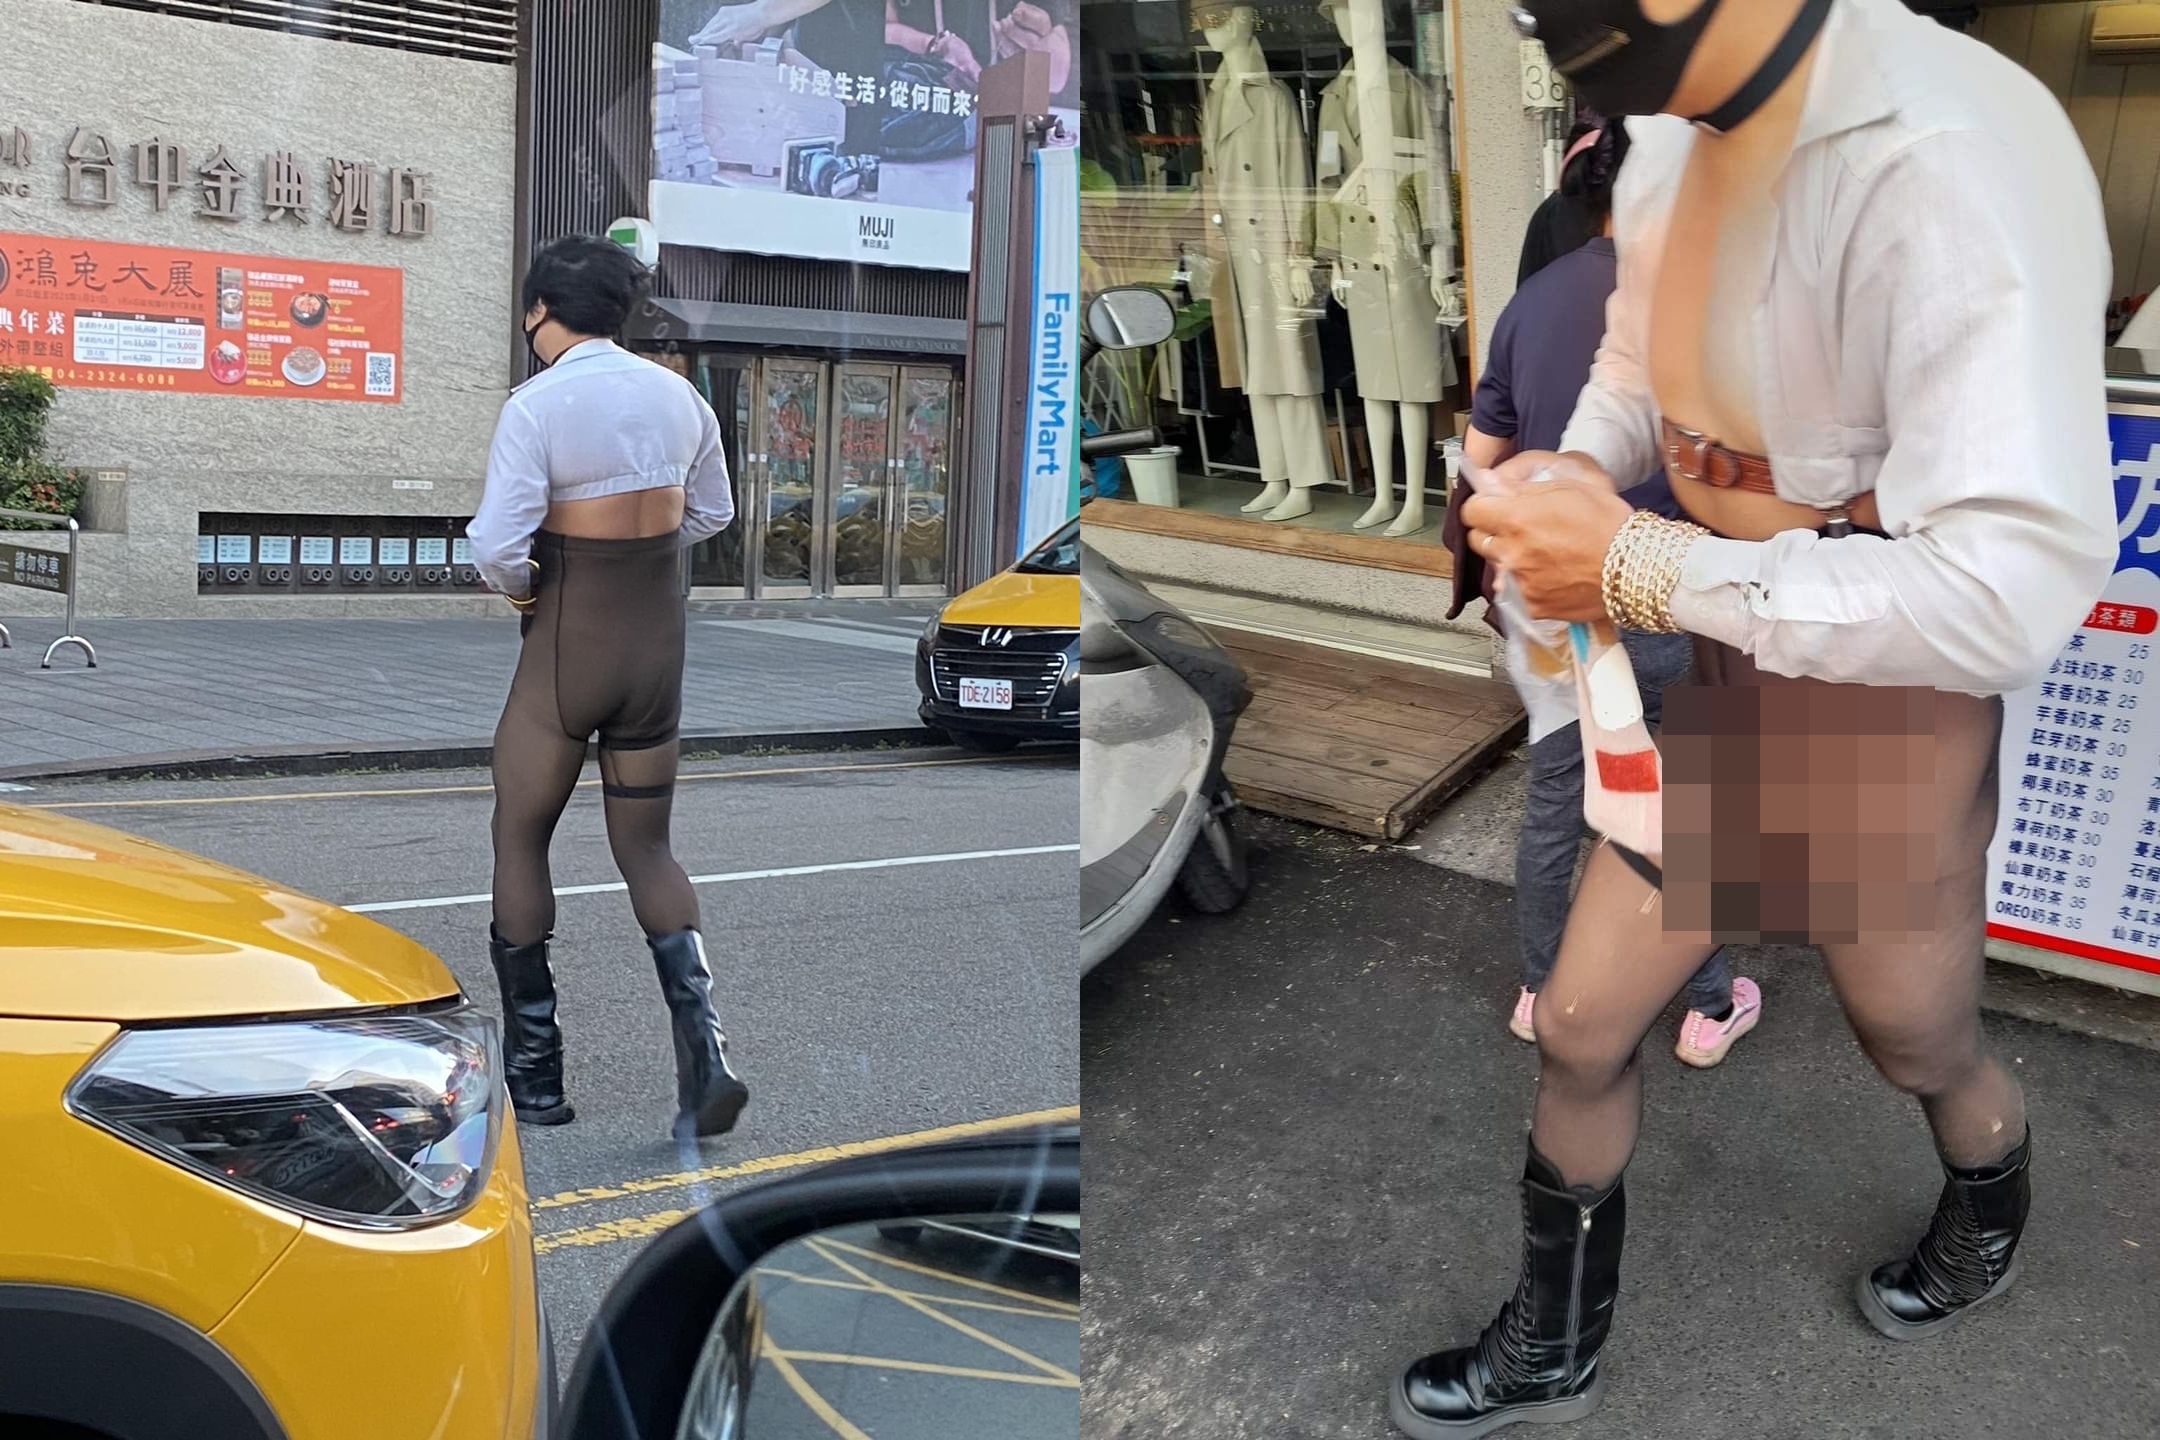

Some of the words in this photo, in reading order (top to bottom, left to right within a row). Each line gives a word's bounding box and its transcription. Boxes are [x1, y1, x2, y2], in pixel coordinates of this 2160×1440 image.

[64, 126, 435, 238] 台中金典酒店
[859, 215, 894, 239] MUJI
[15, 248, 204, 299] 鴻兔大展
[57, 368, 175, 386] 04-2324-6088
[1035, 293, 1070, 477] FamilyMart
[15, 550, 60, 576] 請勿停車
[14, 571, 25, 583] NO
[26, 573, 60, 589] PARKING
[2128, 643, 2150, 660] 25
[2123, 668, 2144, 685] 30
[962, 685, 1011, 705] TDE-2158
[2117, 693, 2138, 709] 25
[2112, 717, 2131, 734] 25
[2106, 742, 2127, 758] 30
[2101, 765, 2120, 781] 35
[2095, 788, 2114, 804] 30
[2089, 810, 2110, 826] 30
[2082, 832, 2102, 847] 30
[2077, 853, 2097, 868] 30
[2074, 875, 2092, 889] 35
[2069, 896, 2088, 910] 35
[2064, 916, 2083, 930] 35
